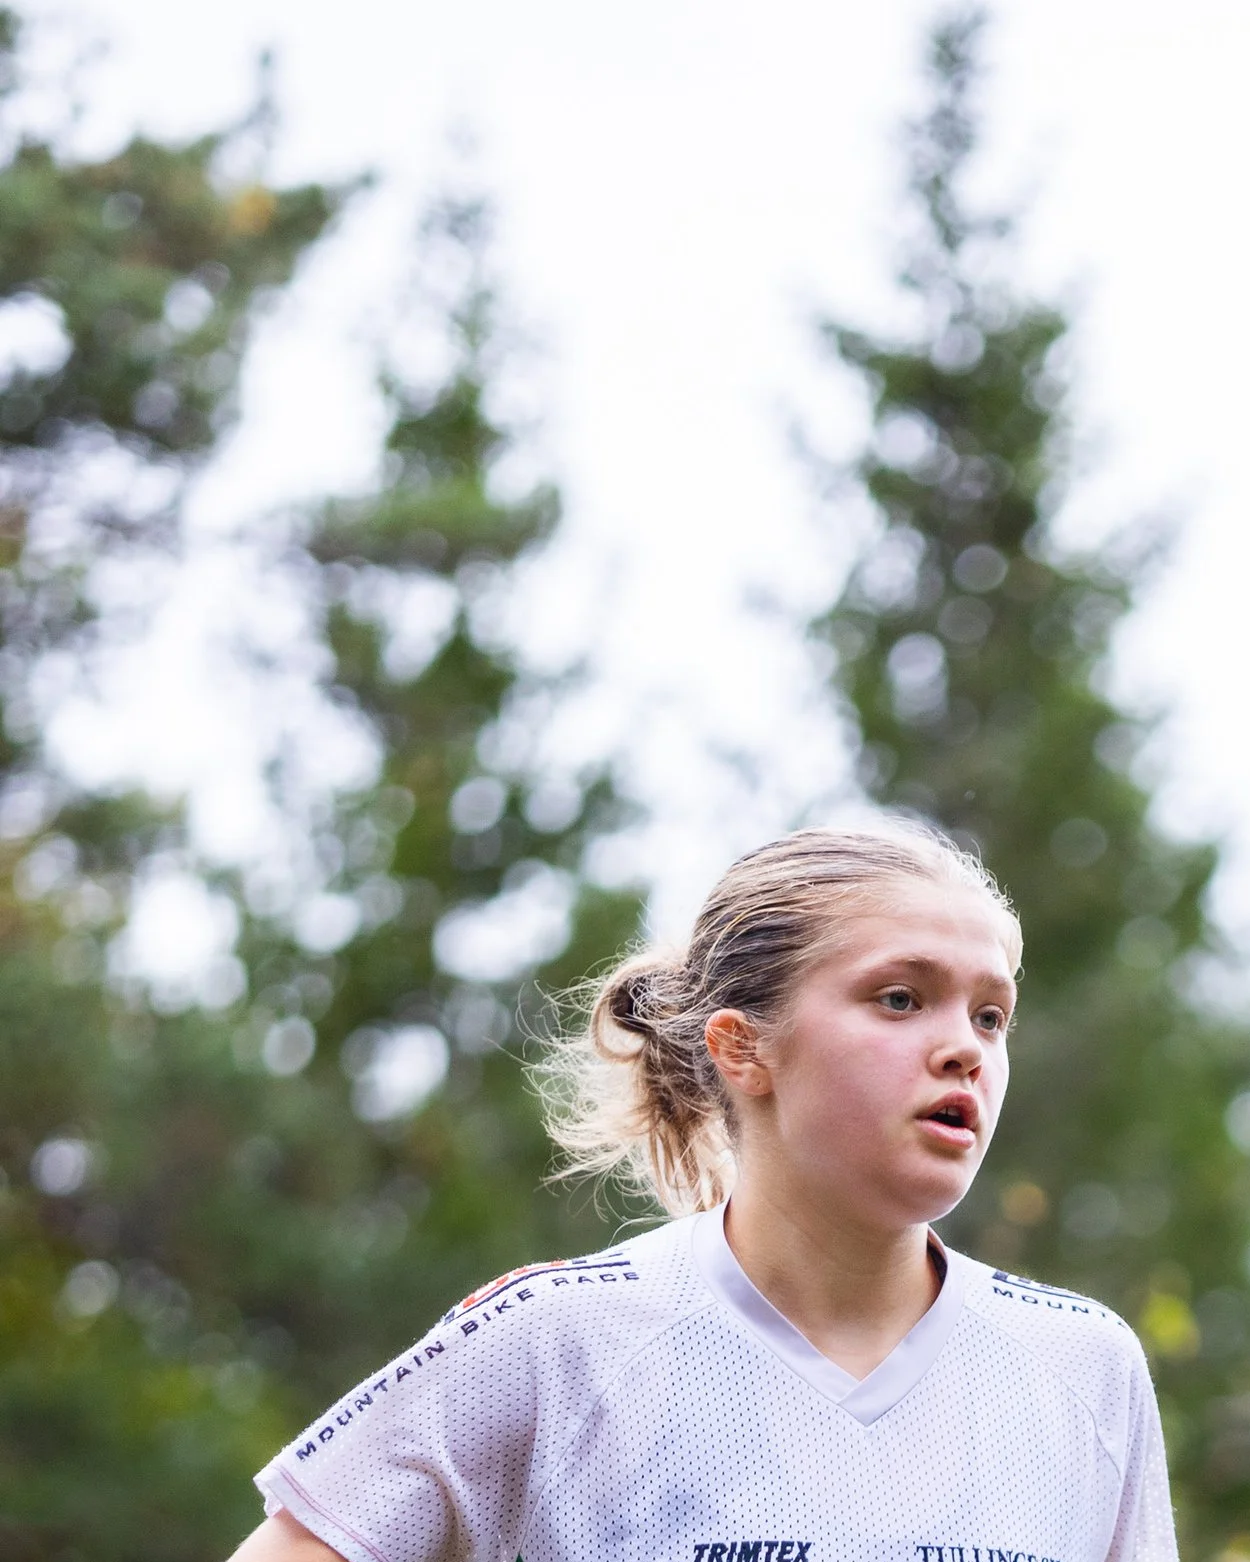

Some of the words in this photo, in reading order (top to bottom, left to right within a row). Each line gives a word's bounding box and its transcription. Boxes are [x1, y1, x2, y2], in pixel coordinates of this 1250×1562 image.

[296, 1341, 446, 1462] MOUNTAIN
[460, 1288, 535, 1338] BIKE
[551, 1270, 641, 1288] RACE
